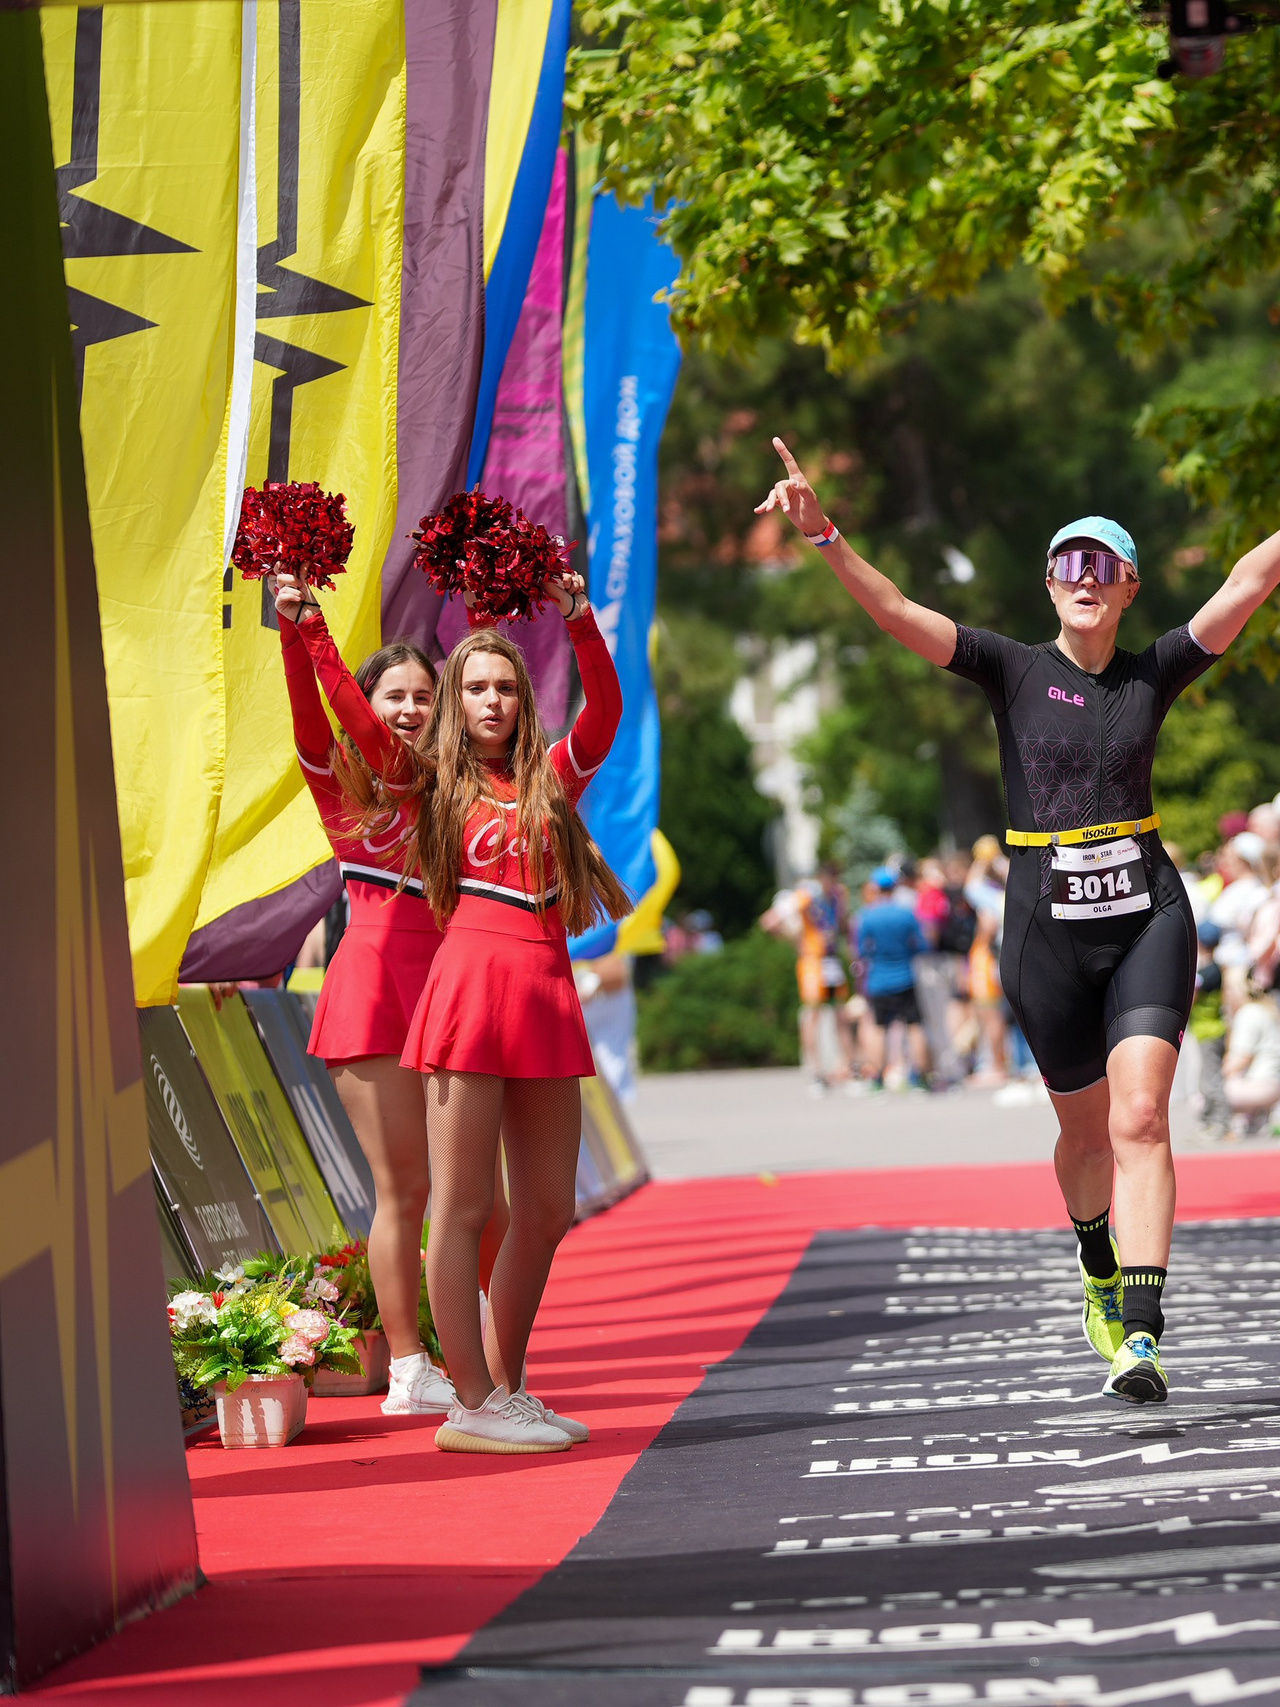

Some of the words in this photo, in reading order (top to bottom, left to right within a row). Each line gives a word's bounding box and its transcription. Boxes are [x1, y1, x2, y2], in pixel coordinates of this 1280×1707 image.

[615, 375, 641, 441] ДОМ
[605, 441, 637, 600] СТРАХОВОЙ
[1083, 826, 1119, 840] isostar
[1100, 849, 1113, 858] STAR
[1067, 869, 1132, 901] 3014
[1093, 904, 1113, 913] OLGA
[808, 1449, 1080, 1473] IRON
[774, 1523, 1087, 1551] IRON
[717, 1618, 1094, 1648] IRON
[684, 1675, 1101, 1706] IRON
